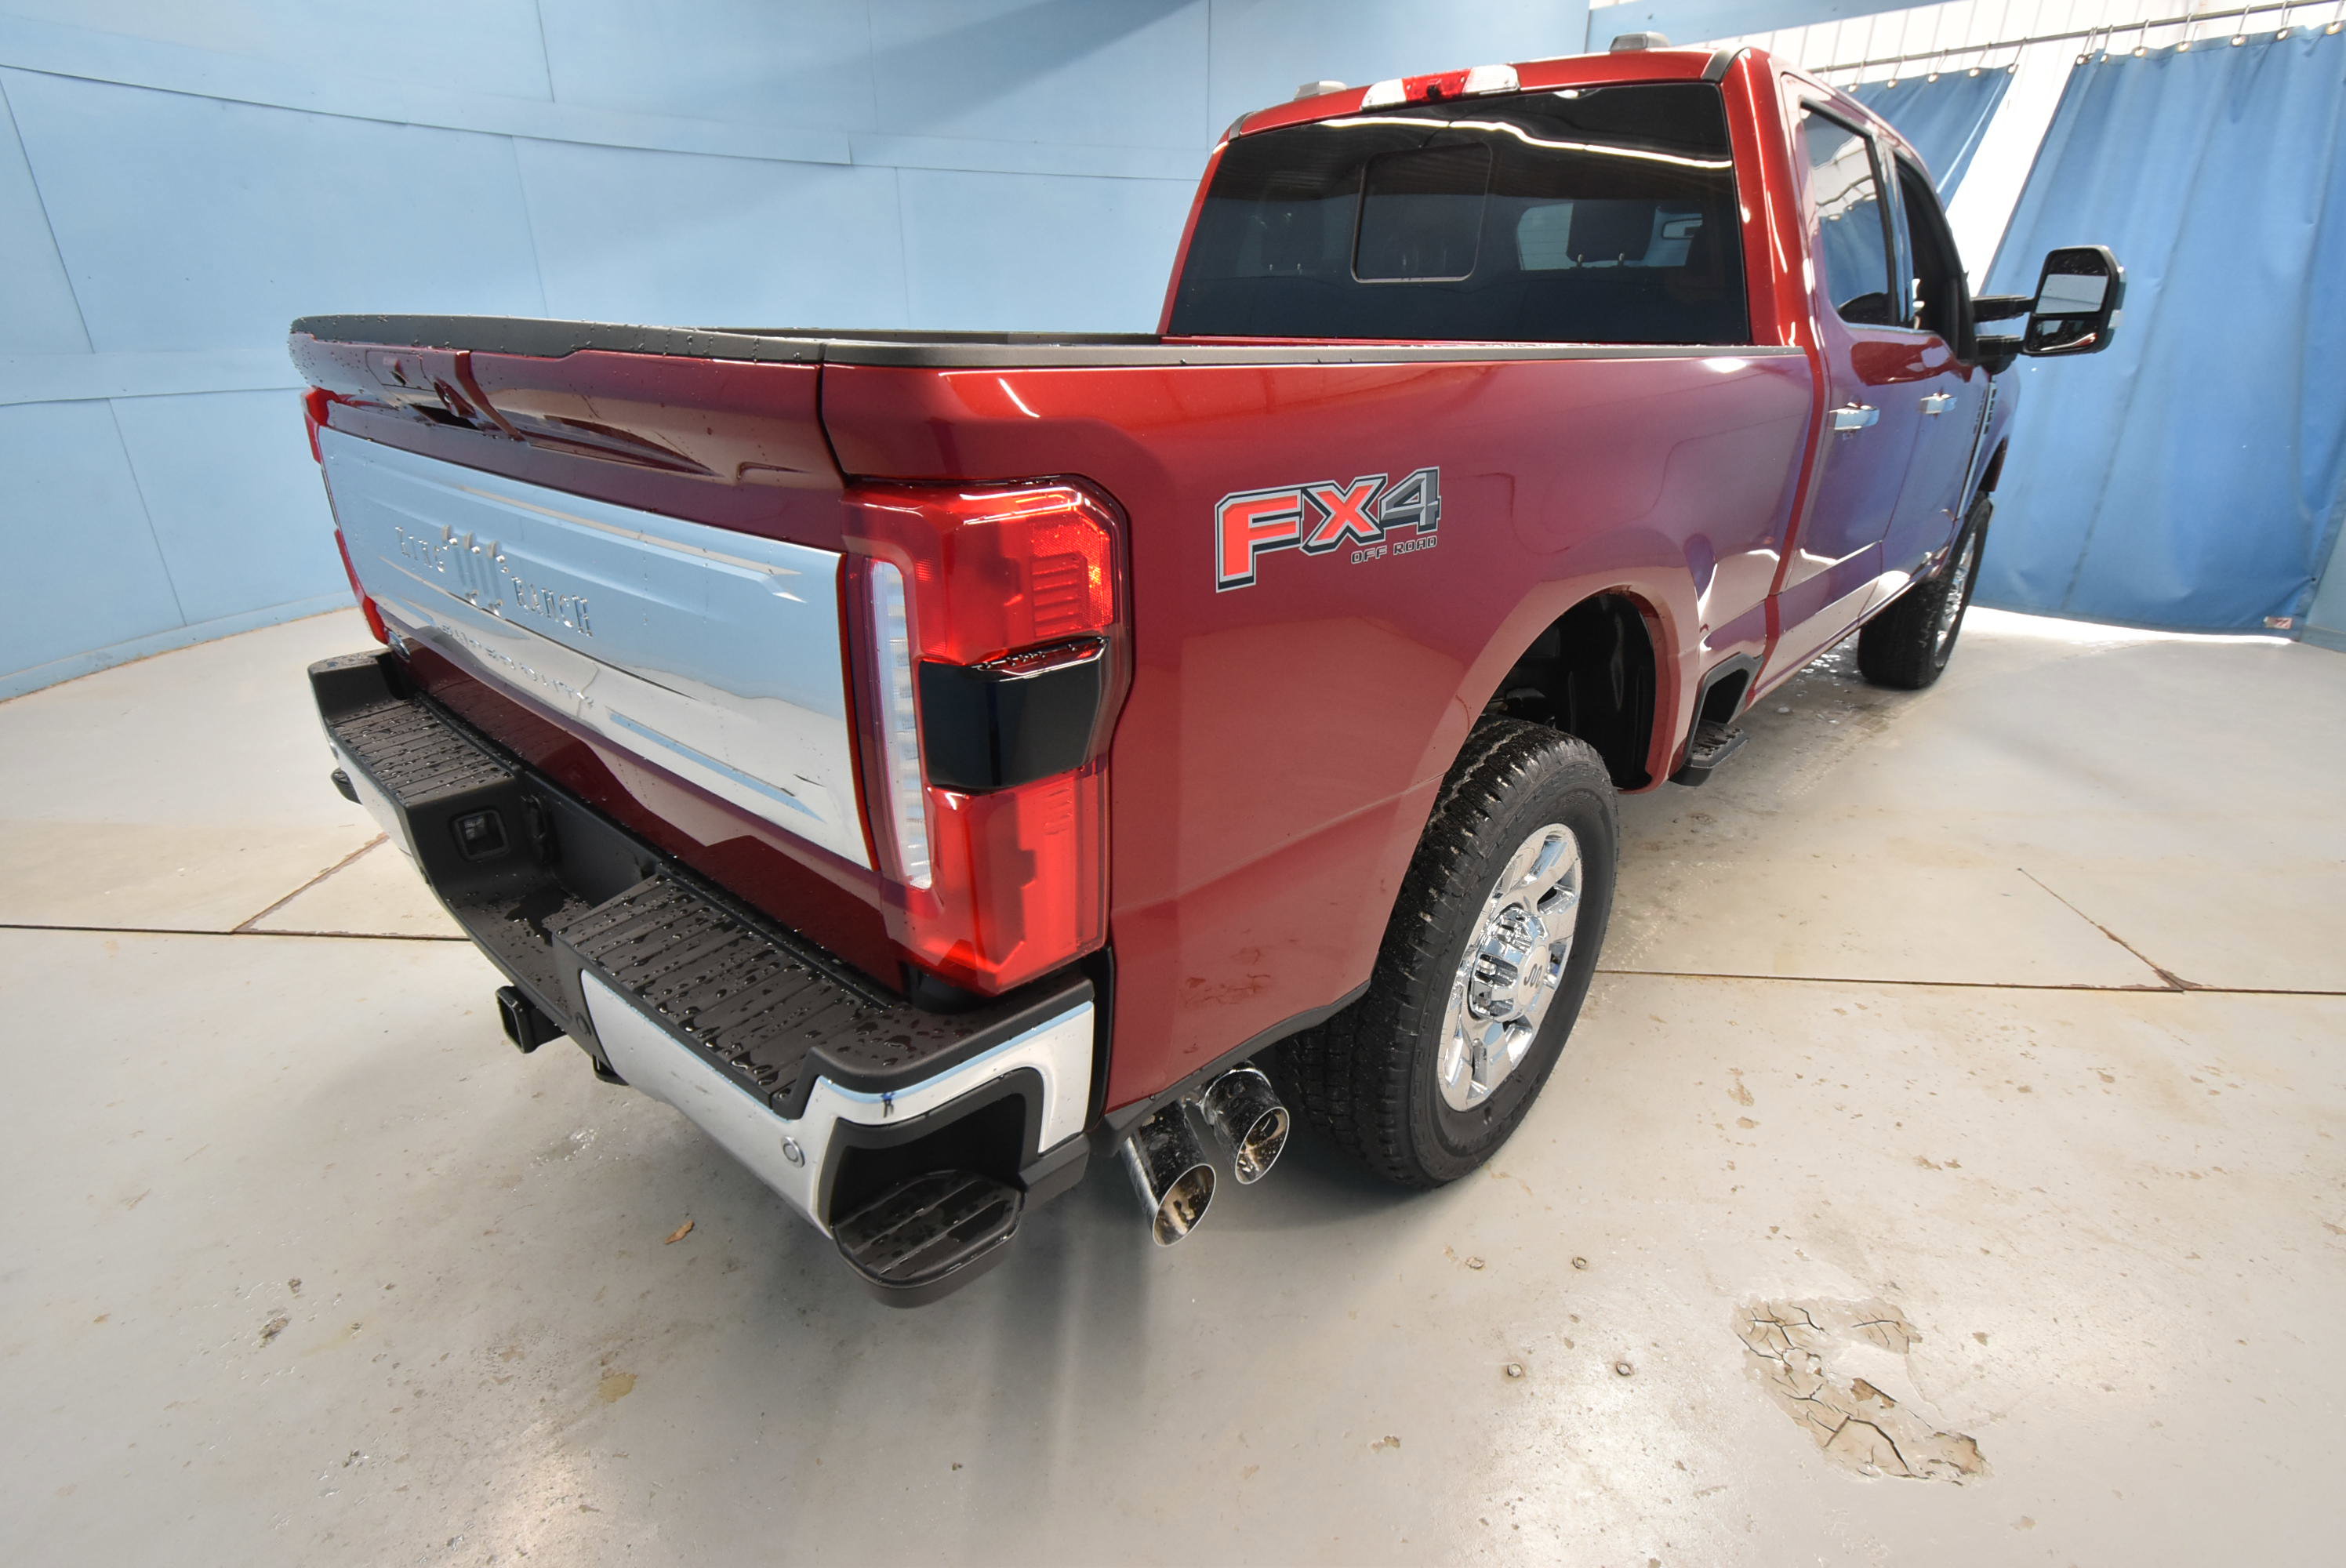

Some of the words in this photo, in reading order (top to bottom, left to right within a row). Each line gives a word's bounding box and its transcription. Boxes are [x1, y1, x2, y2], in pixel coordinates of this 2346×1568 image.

[1215, 466, 1442, 593] FX4
[1350, 545, 1388, 564] OFF
[1393, 535, 1438, 556] ROAD
